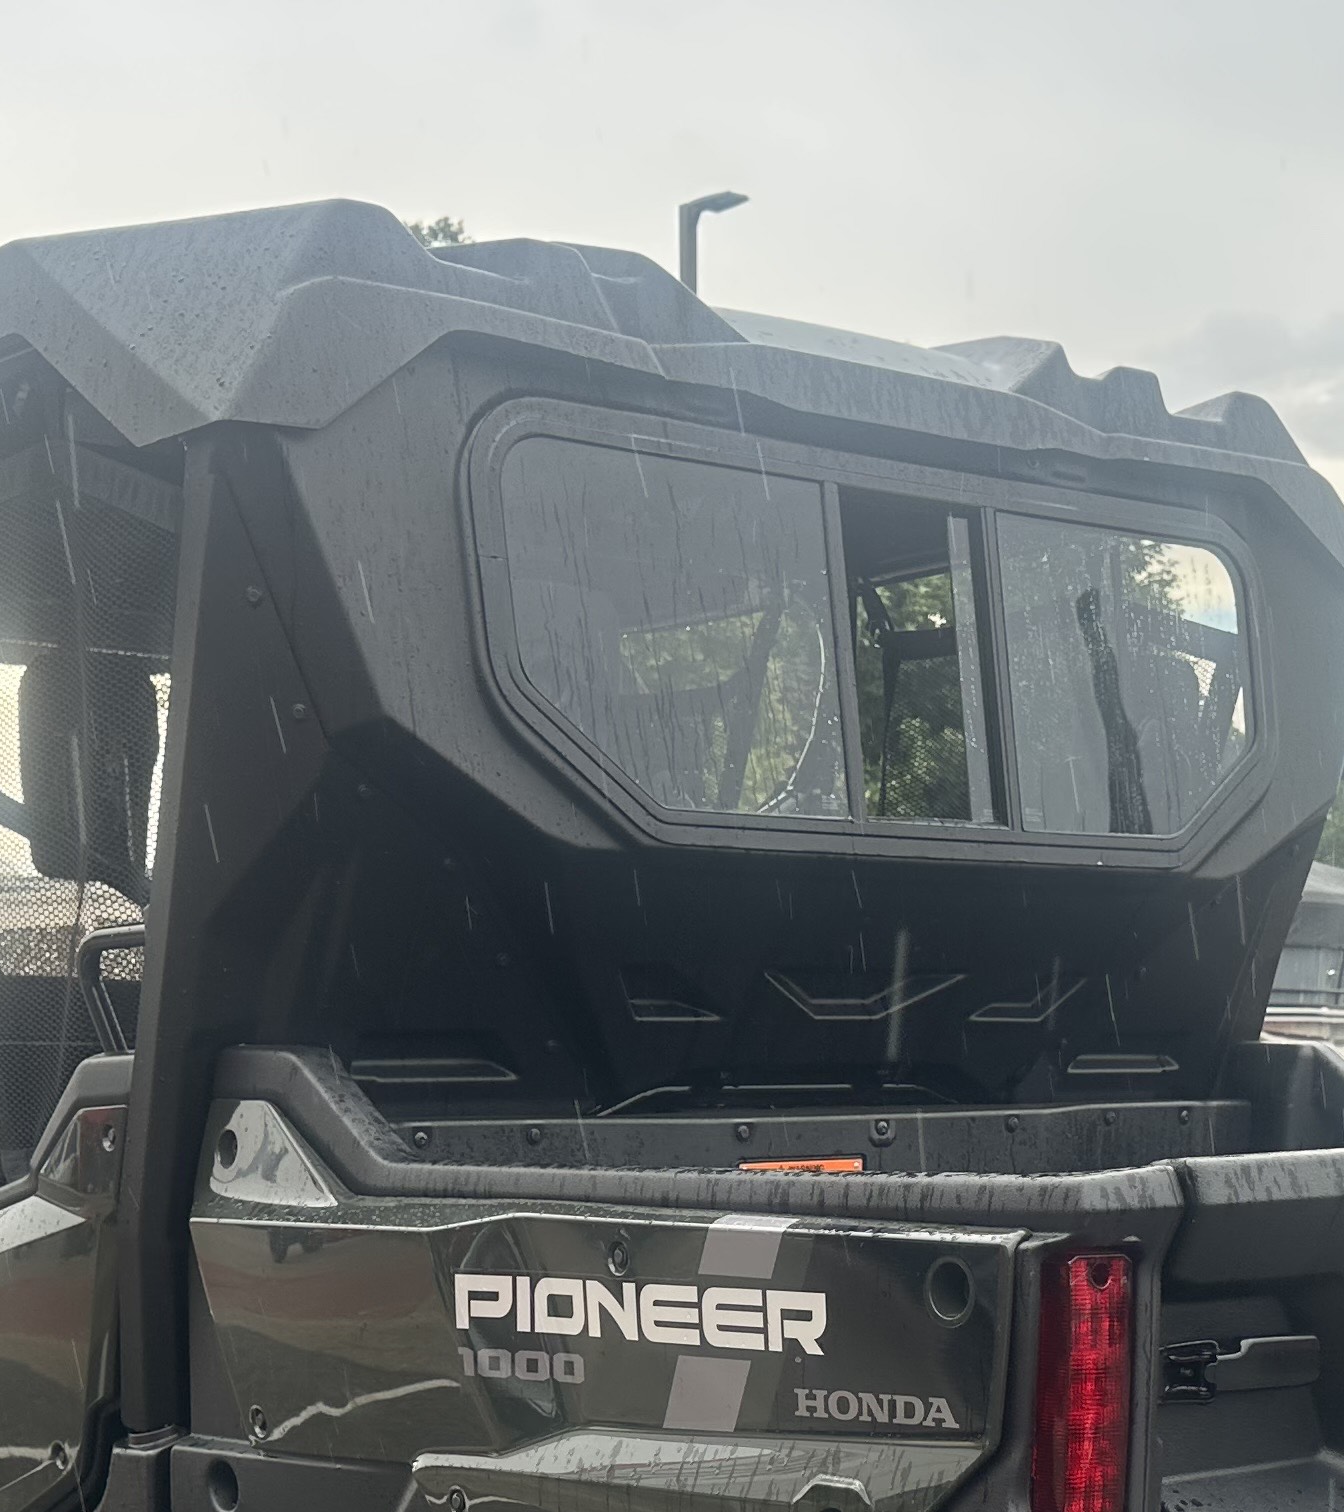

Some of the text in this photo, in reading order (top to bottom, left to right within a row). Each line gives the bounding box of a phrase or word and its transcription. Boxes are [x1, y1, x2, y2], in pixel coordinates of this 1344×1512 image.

[454, 1273, 827, 1356] PIONEER
[457, 1346, 585, 1385] 1000
[793, 1387, 960, 1429] HONDA
